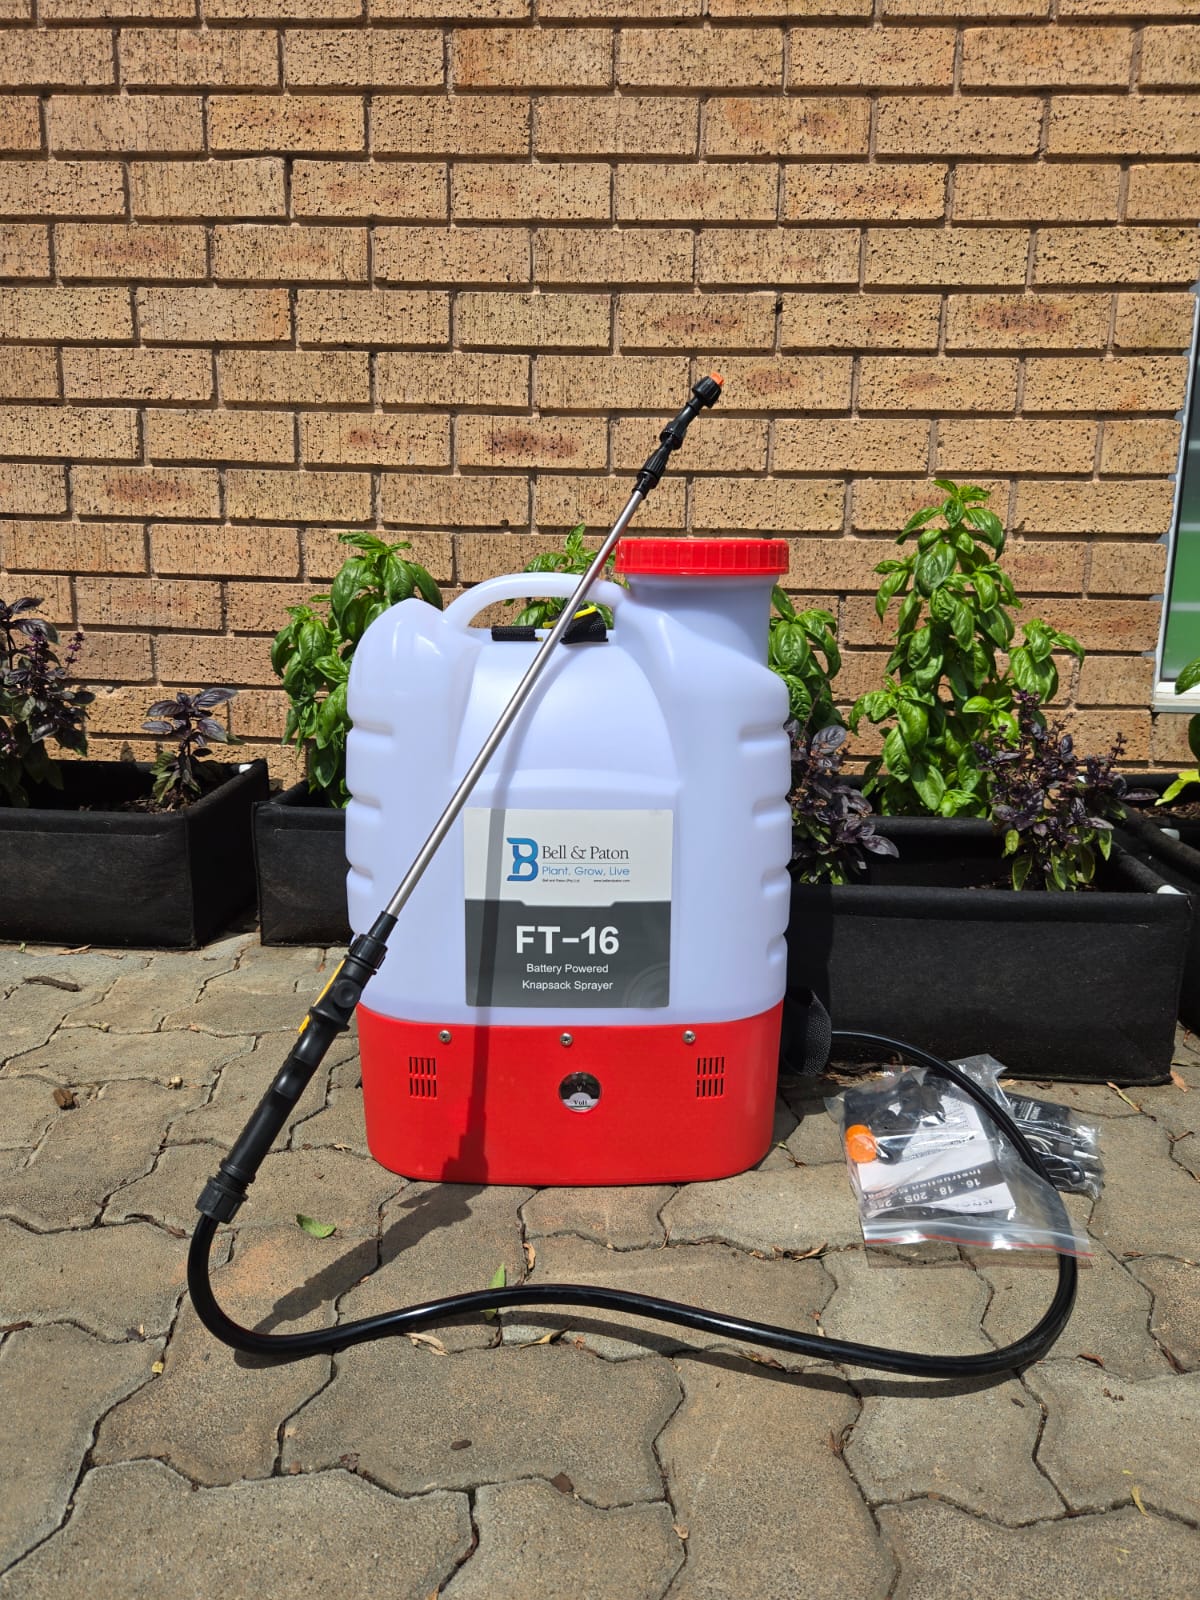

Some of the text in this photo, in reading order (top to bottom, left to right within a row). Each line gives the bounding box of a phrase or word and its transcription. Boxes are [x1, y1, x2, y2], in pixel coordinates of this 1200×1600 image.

[542, 845, 629, 860] Bell & Paton
[609, 866, 630, 876] Live
[516, 925, 619, 955] FT-16
[526, 963, 609, 975] Battery Powered
[522, 980, 614, 992] Knapsack Sprayer
